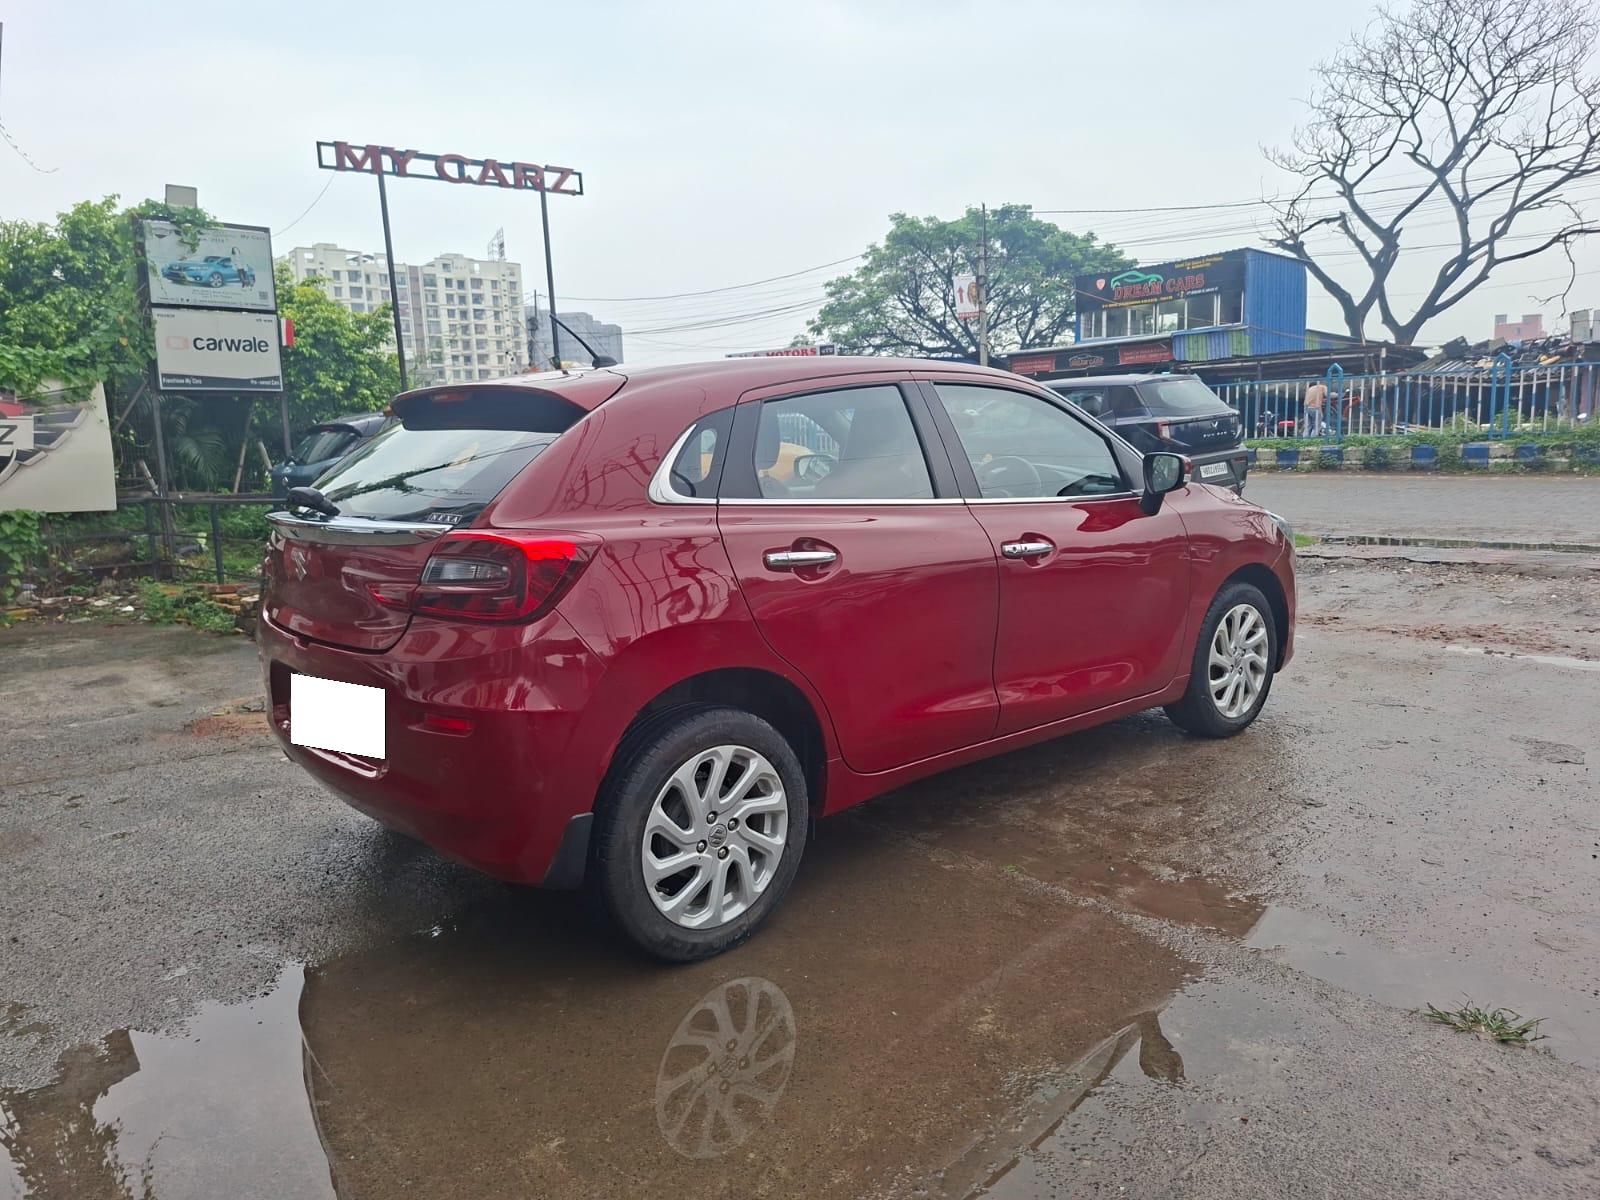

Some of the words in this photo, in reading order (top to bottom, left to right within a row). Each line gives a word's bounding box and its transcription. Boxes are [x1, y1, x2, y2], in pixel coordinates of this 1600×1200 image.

[333, 141, 419, 178] MY
[435, 154, 577, 196] CARZ
[1114, 280, 1162, 300] DREAM
[1166, 273, 1205, 293] CARS
[193, 336, 269, 353] carwale
[766, 347, 817, 357] MOTORS
[430, 514, 459, 522] NEXA
